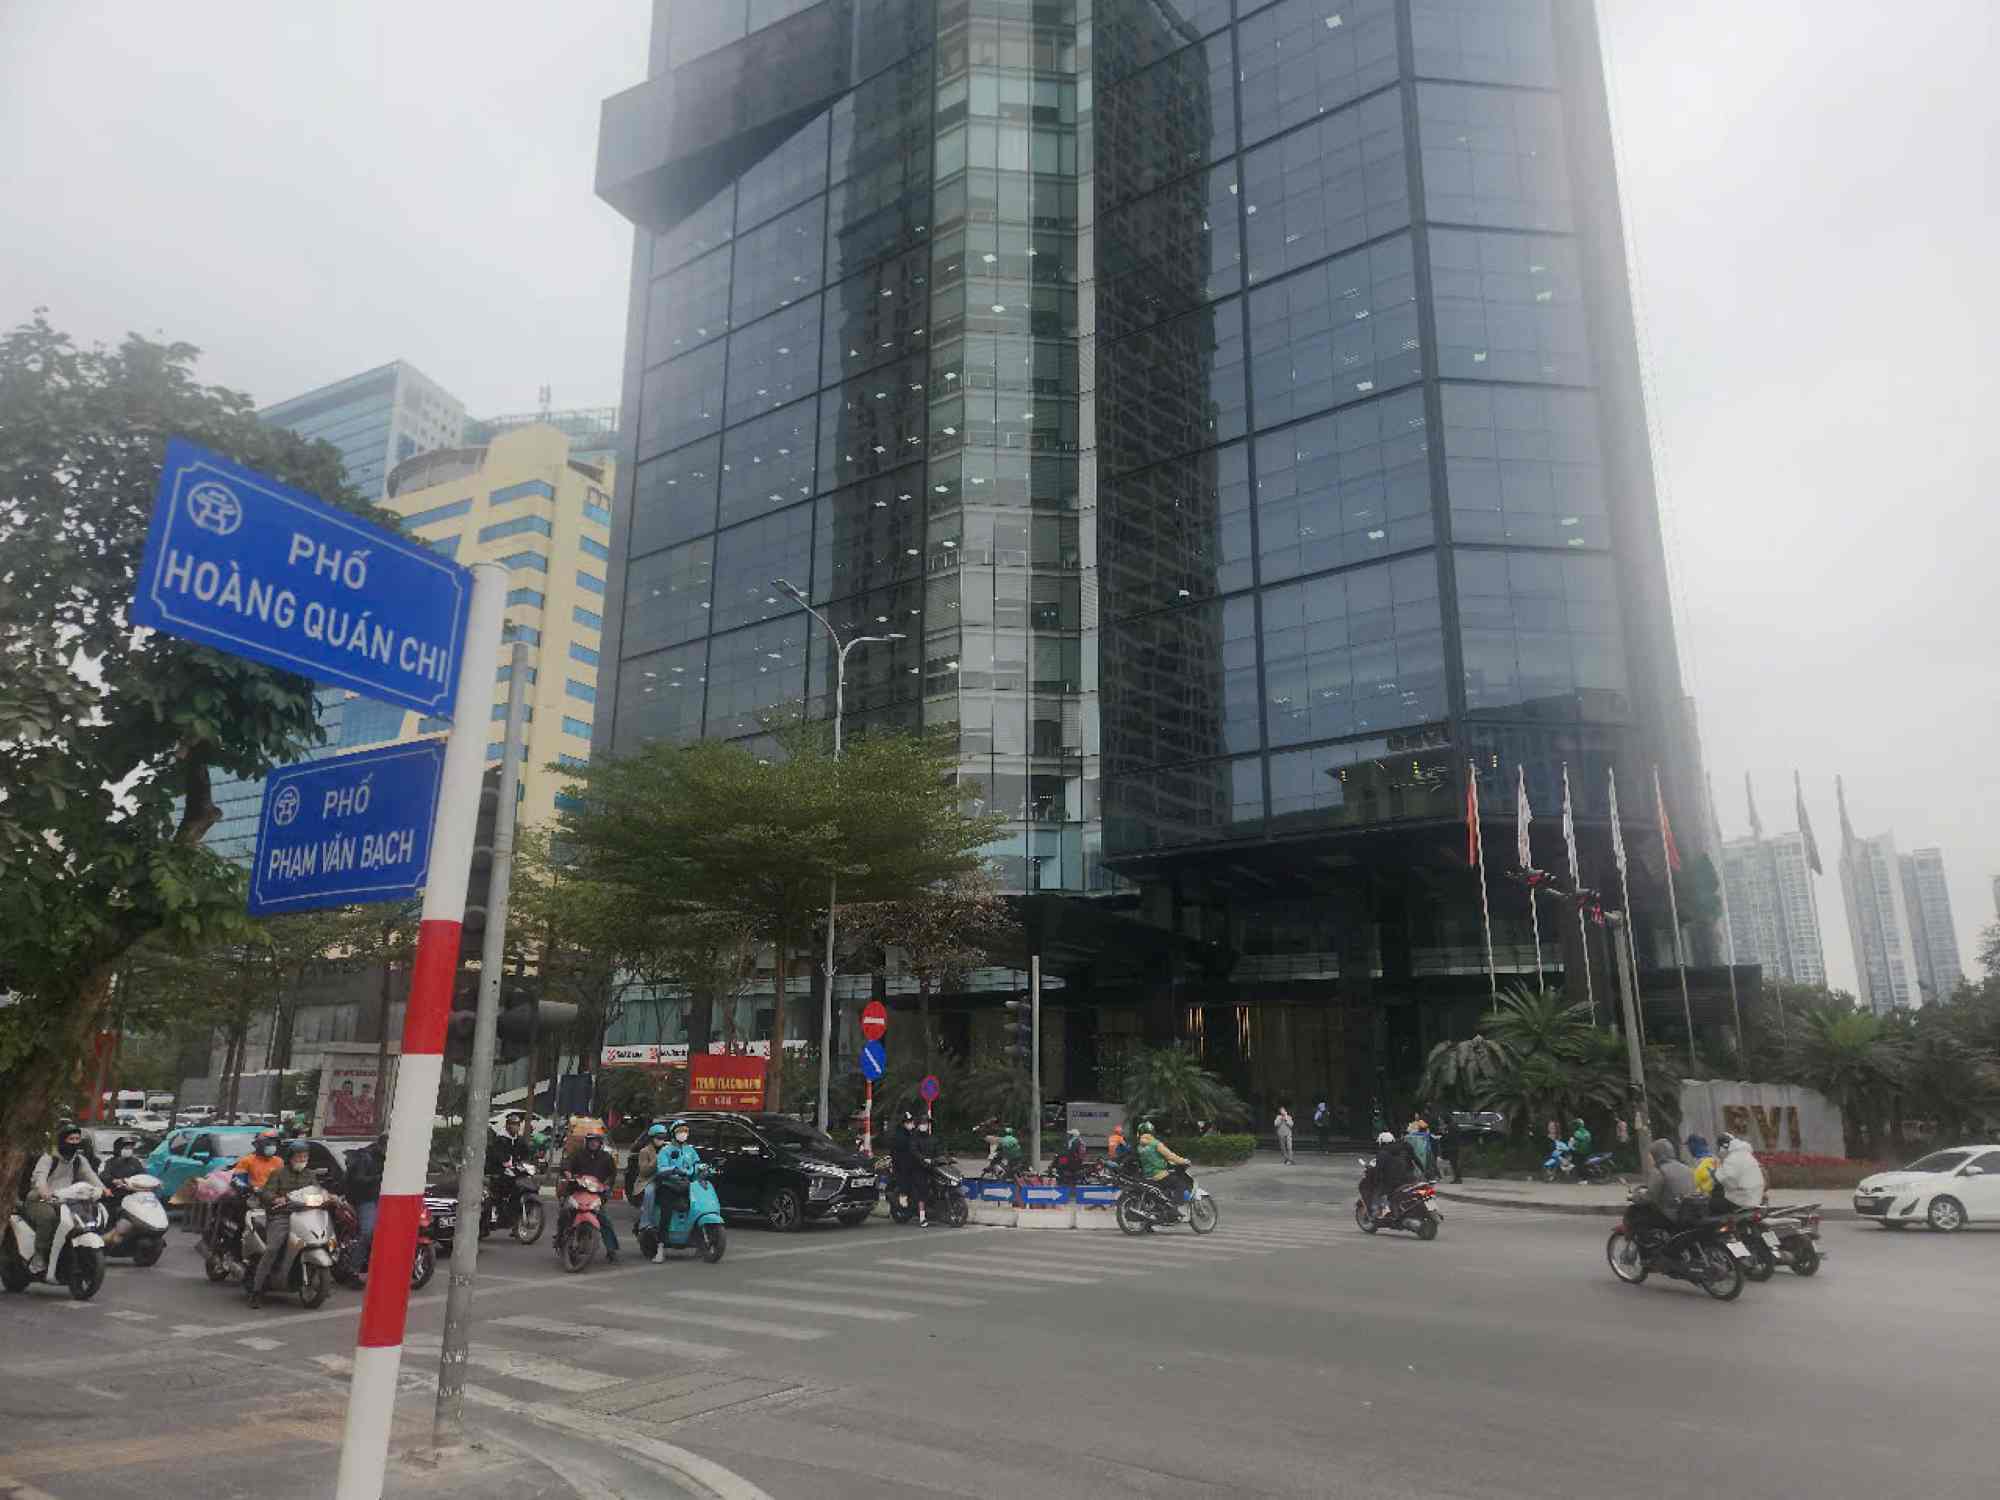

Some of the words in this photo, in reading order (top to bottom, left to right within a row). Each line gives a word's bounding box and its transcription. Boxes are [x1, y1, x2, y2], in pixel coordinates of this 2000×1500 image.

[288, 533, 372, 590] PHỐ
[163, 549, 296, 629] HOÀNG
[303, 602, 393, 665] QUÁN
[399, 637, 449, 683] CHI
[322, 772, 374, 820] PHỐ
[267, 842, 318, 881] PHẠM
[321, 831, 357, 875] VĂN
[360, 828, 416, 872] BẠCH
